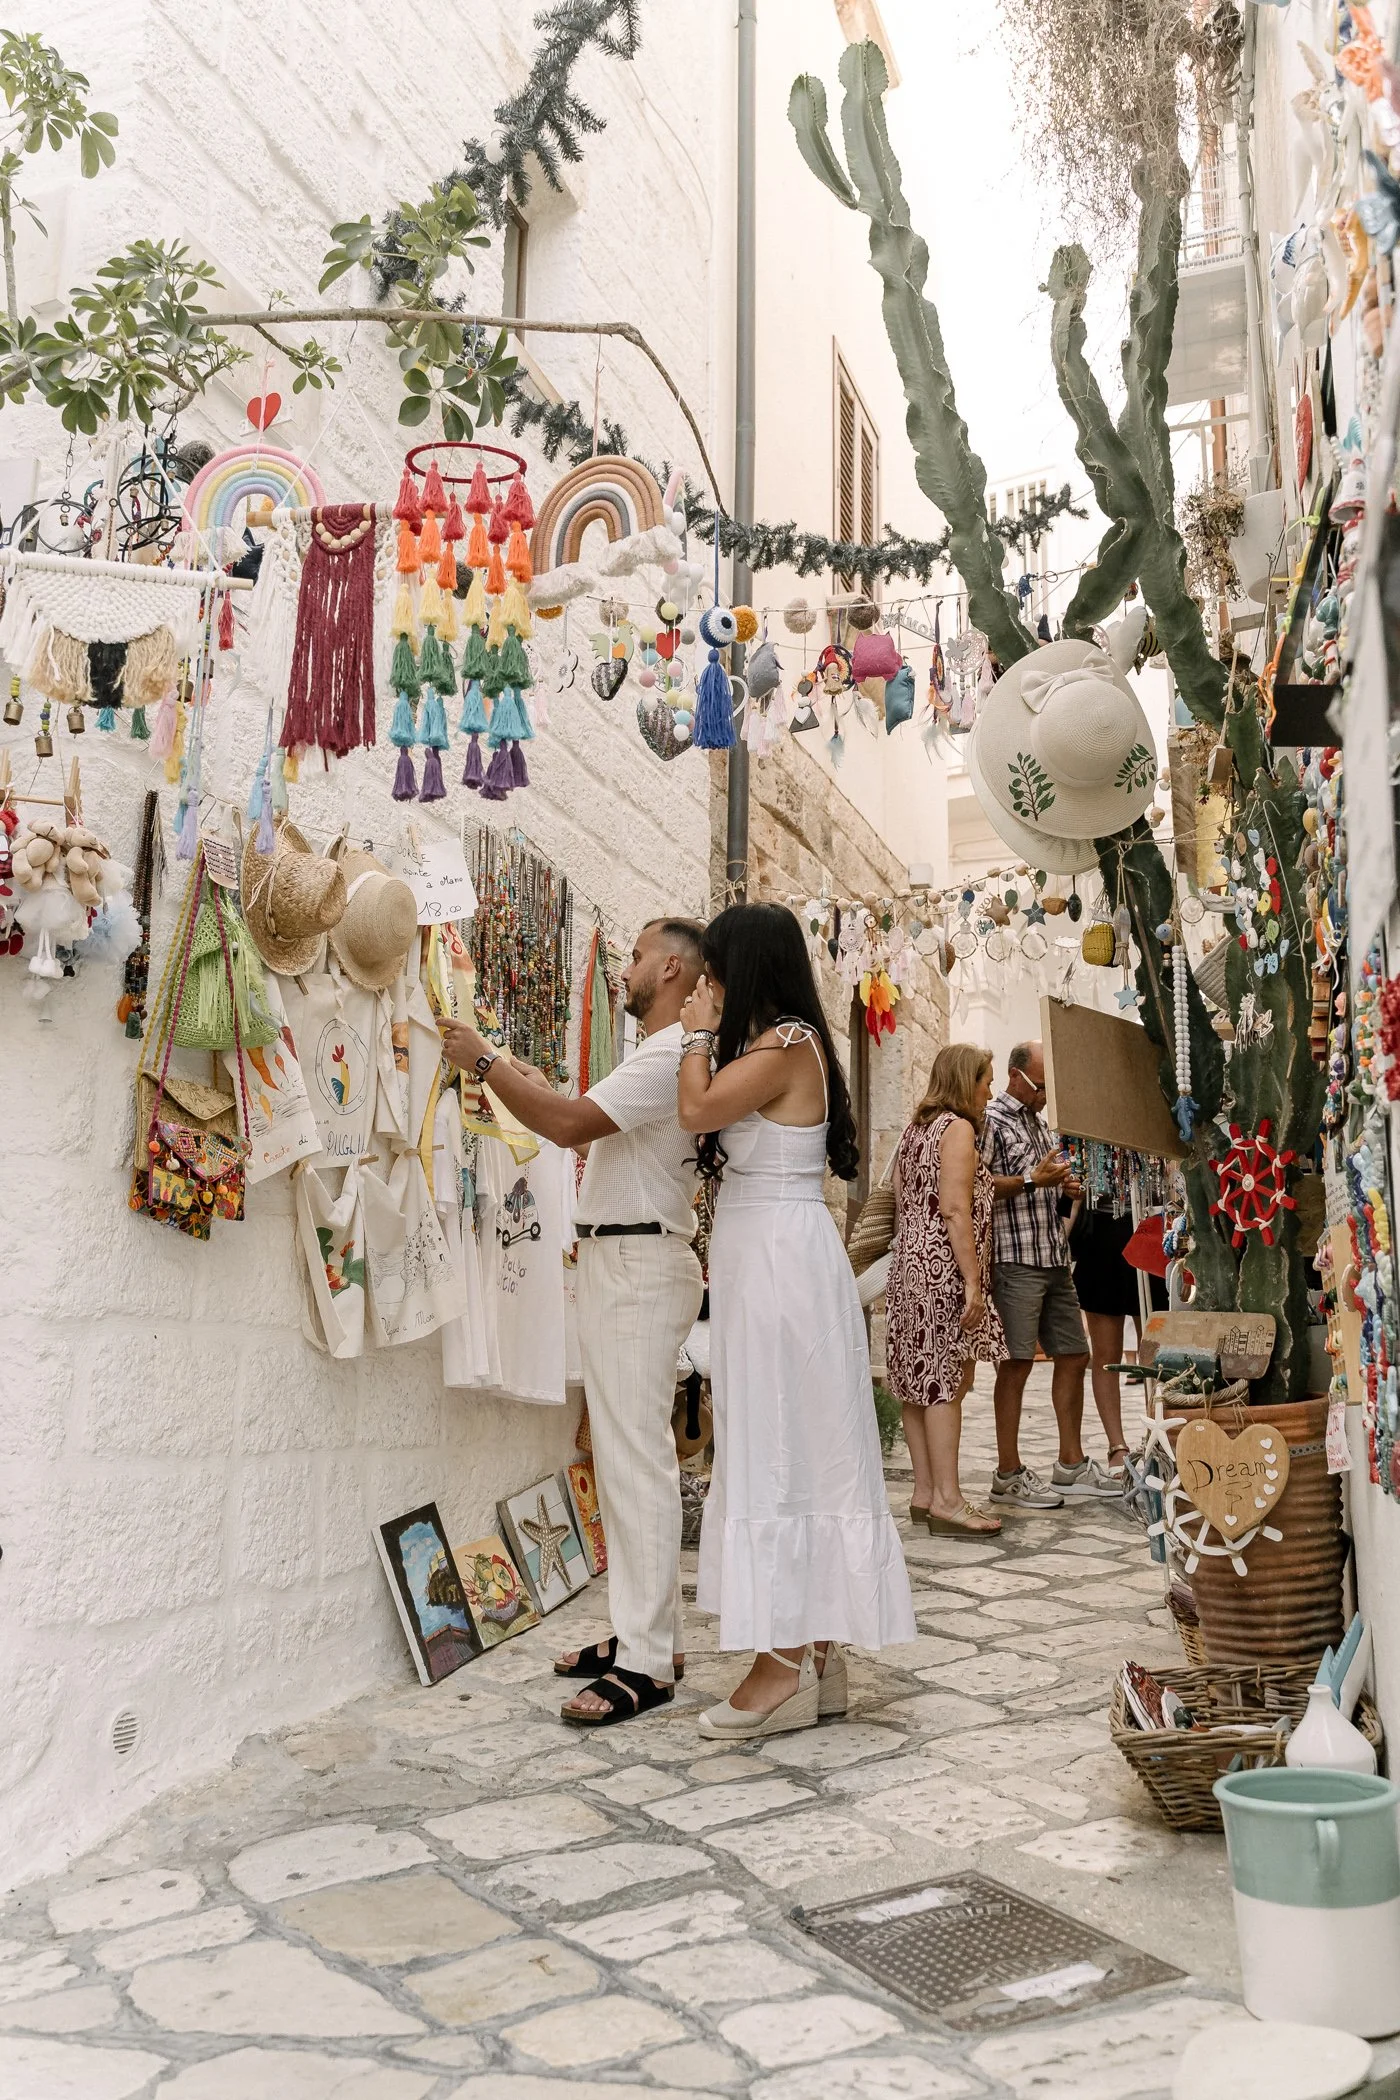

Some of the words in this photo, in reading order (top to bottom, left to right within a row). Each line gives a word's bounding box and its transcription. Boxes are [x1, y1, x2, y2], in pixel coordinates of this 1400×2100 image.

[417, 901, 462, 918] 18,00
[298, 1134, 309, 1146] di
[1187, 1458, 1267, 1493] Dream
